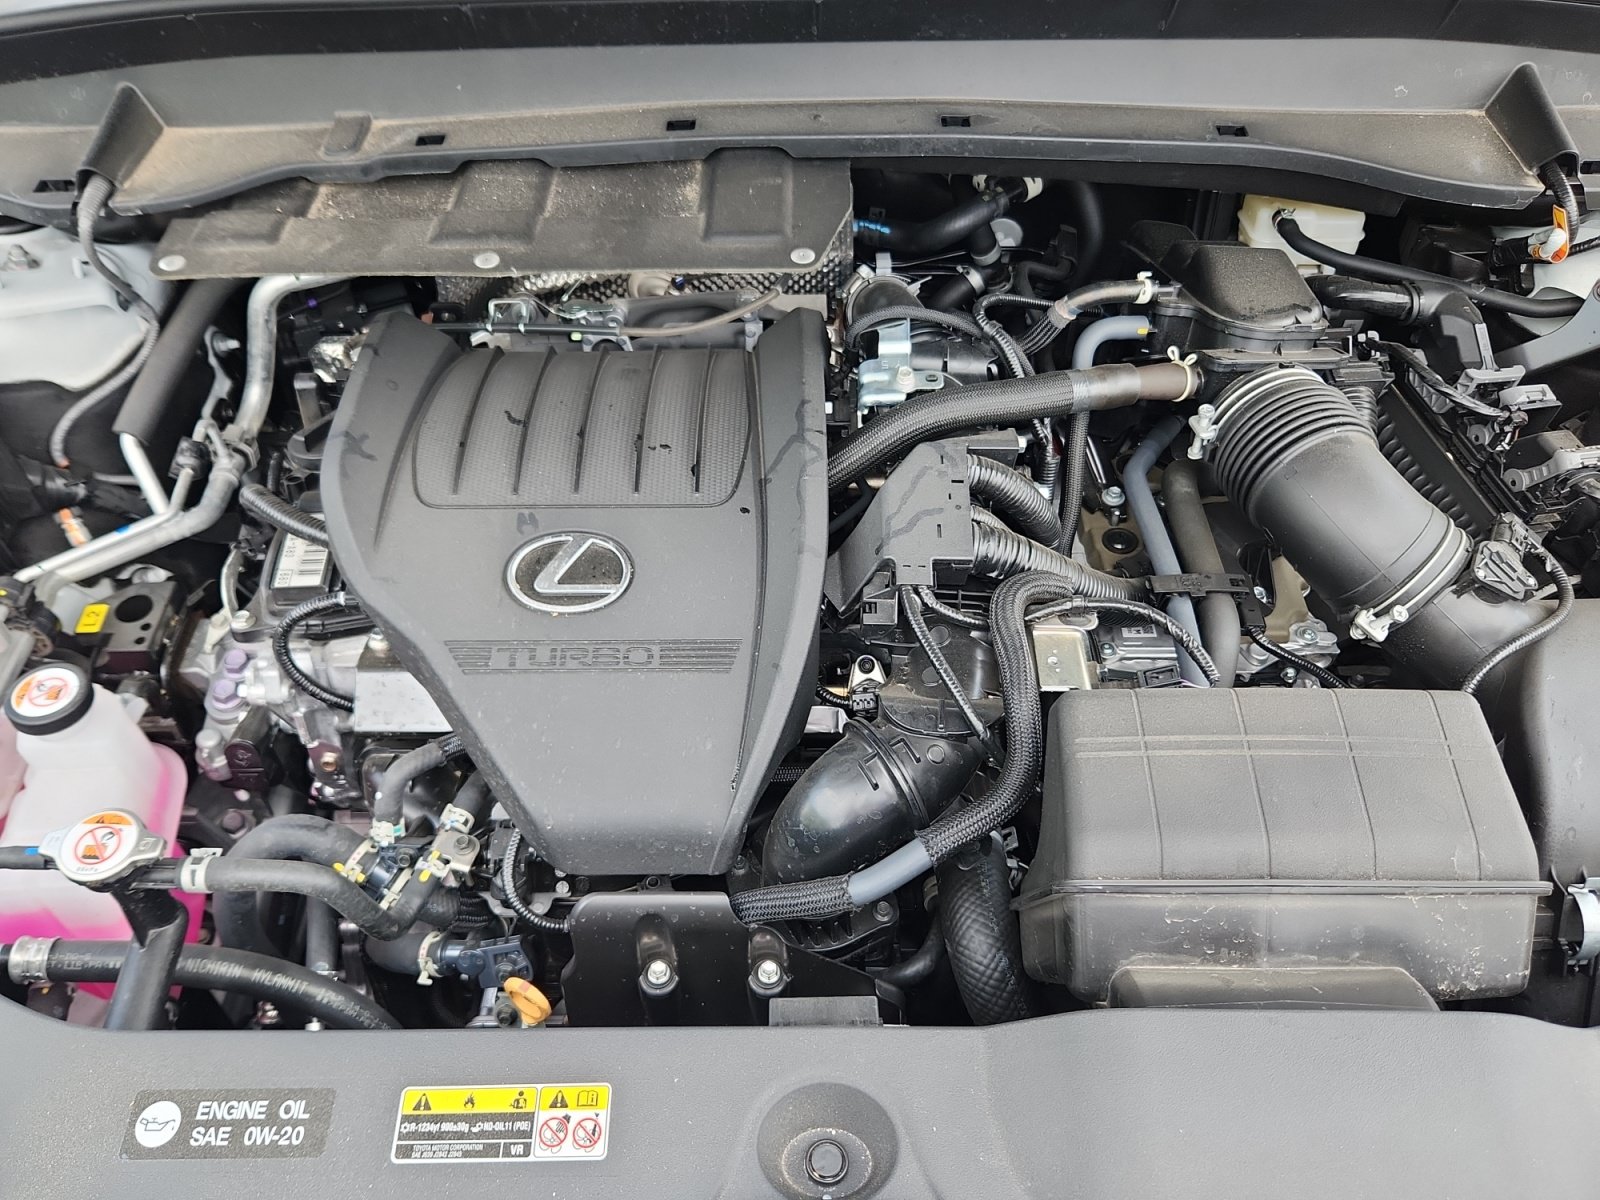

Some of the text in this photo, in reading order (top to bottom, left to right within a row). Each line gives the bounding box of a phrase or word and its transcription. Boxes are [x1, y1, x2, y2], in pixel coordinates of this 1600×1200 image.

[497, 647, 654, 667] TURBO
[195, 1099, 310, 1120] ENGINE OIL
[189, 1125, 305, 1147] SAE 0W-20
[510, 1144, 524, 1155] VR
